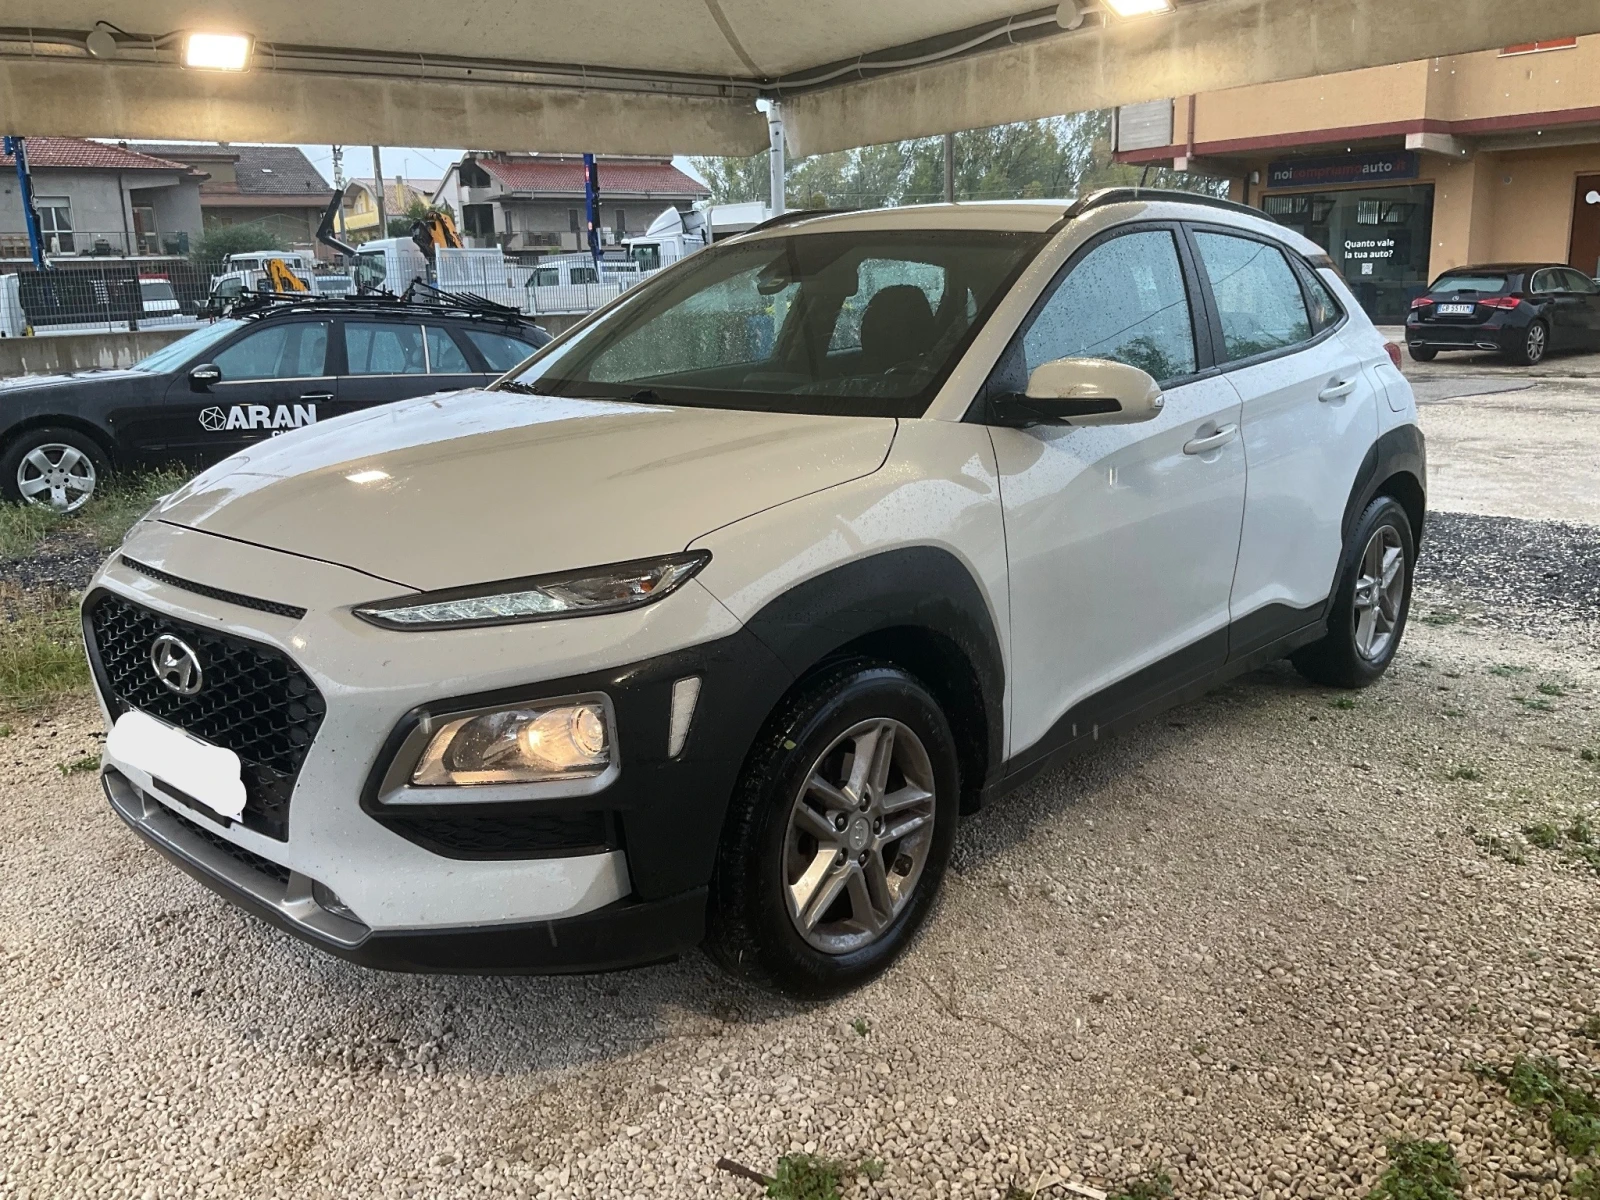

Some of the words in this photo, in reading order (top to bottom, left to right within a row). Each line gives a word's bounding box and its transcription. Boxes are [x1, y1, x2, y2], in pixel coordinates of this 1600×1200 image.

[1344, 240, 1375, 249] Quanto
[1377, 239, 1395, 247] vale
[1345, 251, 1352, 259] la
[1354, 251, 1368, 259] tua
[1369, 250, 1394, 258] auto?
[225, 404, 317, 430] ARAN
